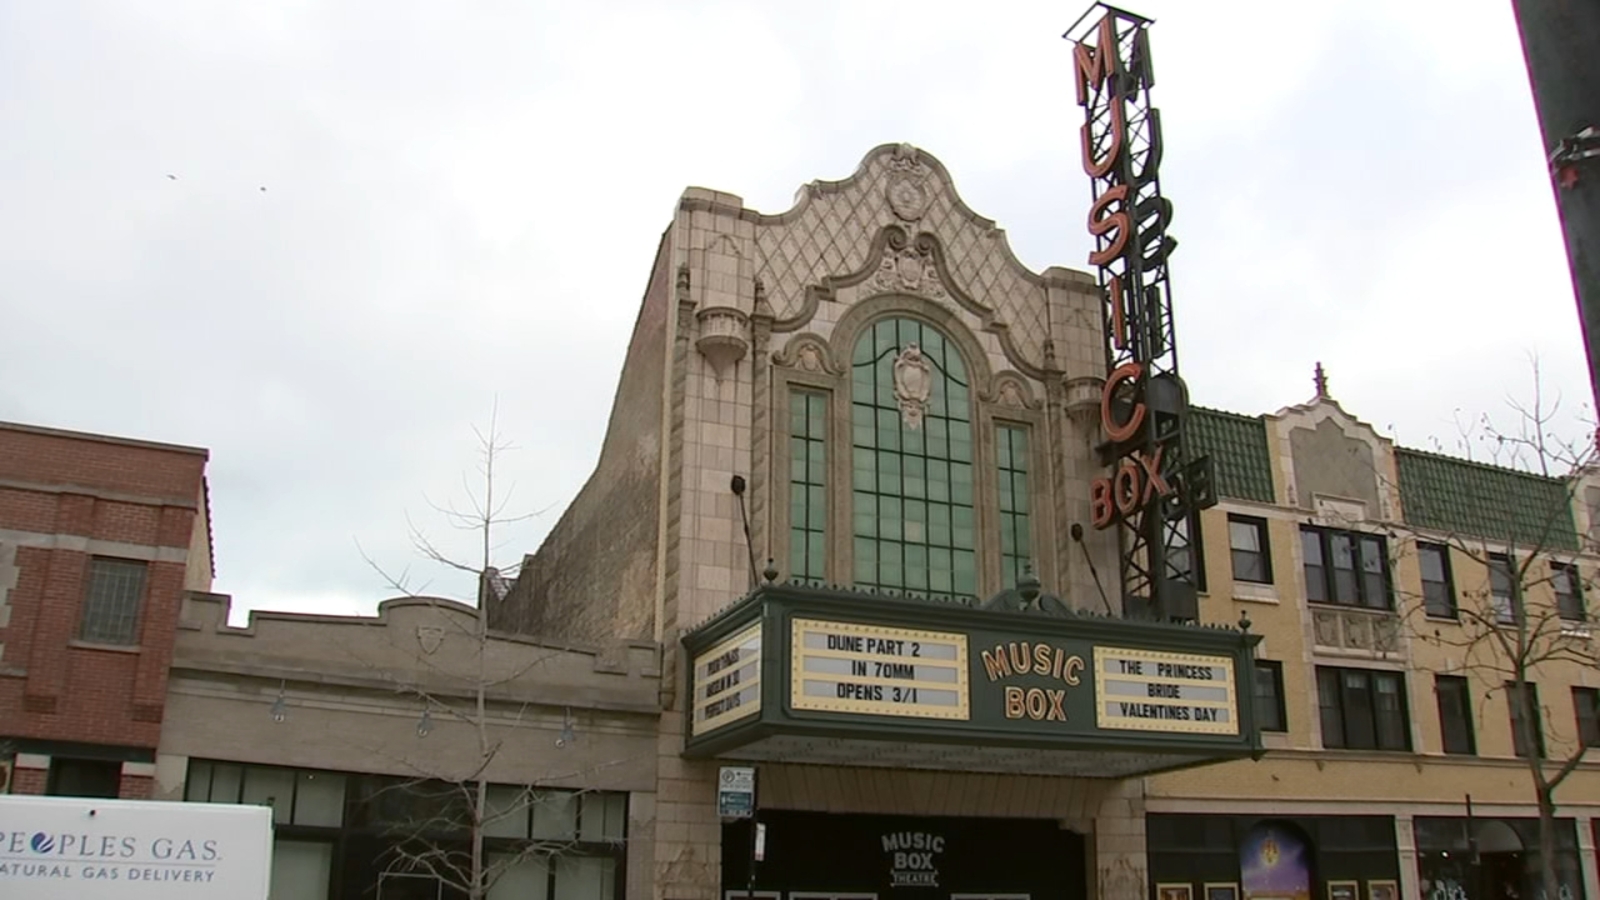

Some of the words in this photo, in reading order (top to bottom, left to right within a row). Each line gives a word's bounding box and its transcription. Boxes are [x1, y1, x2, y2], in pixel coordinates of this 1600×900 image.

[1073, 15, 1146, 442] MUSIC
[1090, 443, 1171, 531] BOX
[827, 634, 863, 653] DUNE
[866, 637, 904, 656] PART
[911, 642, 920, 657] 2
[852, 660, 867, 677] IN
[875, 662, 914, 680] 70MM
[981, 642, 1085, 686] MUSIC
[1119, 660, 1142, 675] THE
[1157, 662, 1212, 680] PRINCESS
[837, 682, 883, 701] OPENS
[892, 686, 918, 703] 3/1
[1147, 683, 1180, 699] BRIDE
[1005, 686, 1067, 722] BOX
[1120, 703, 1190, 721] VALENTINES
[1195, 707, 1218, 722] DAY
[881, 831, 945, 853] MUSIC
[894, 852, 934, 870] BOX
[0, 863, 72, 878] ATURAL
[82, 866, 119, 880] GAS
[128, 868, 215, 883] DELIVERY
[893, 873, 936, 884] THEATRE
